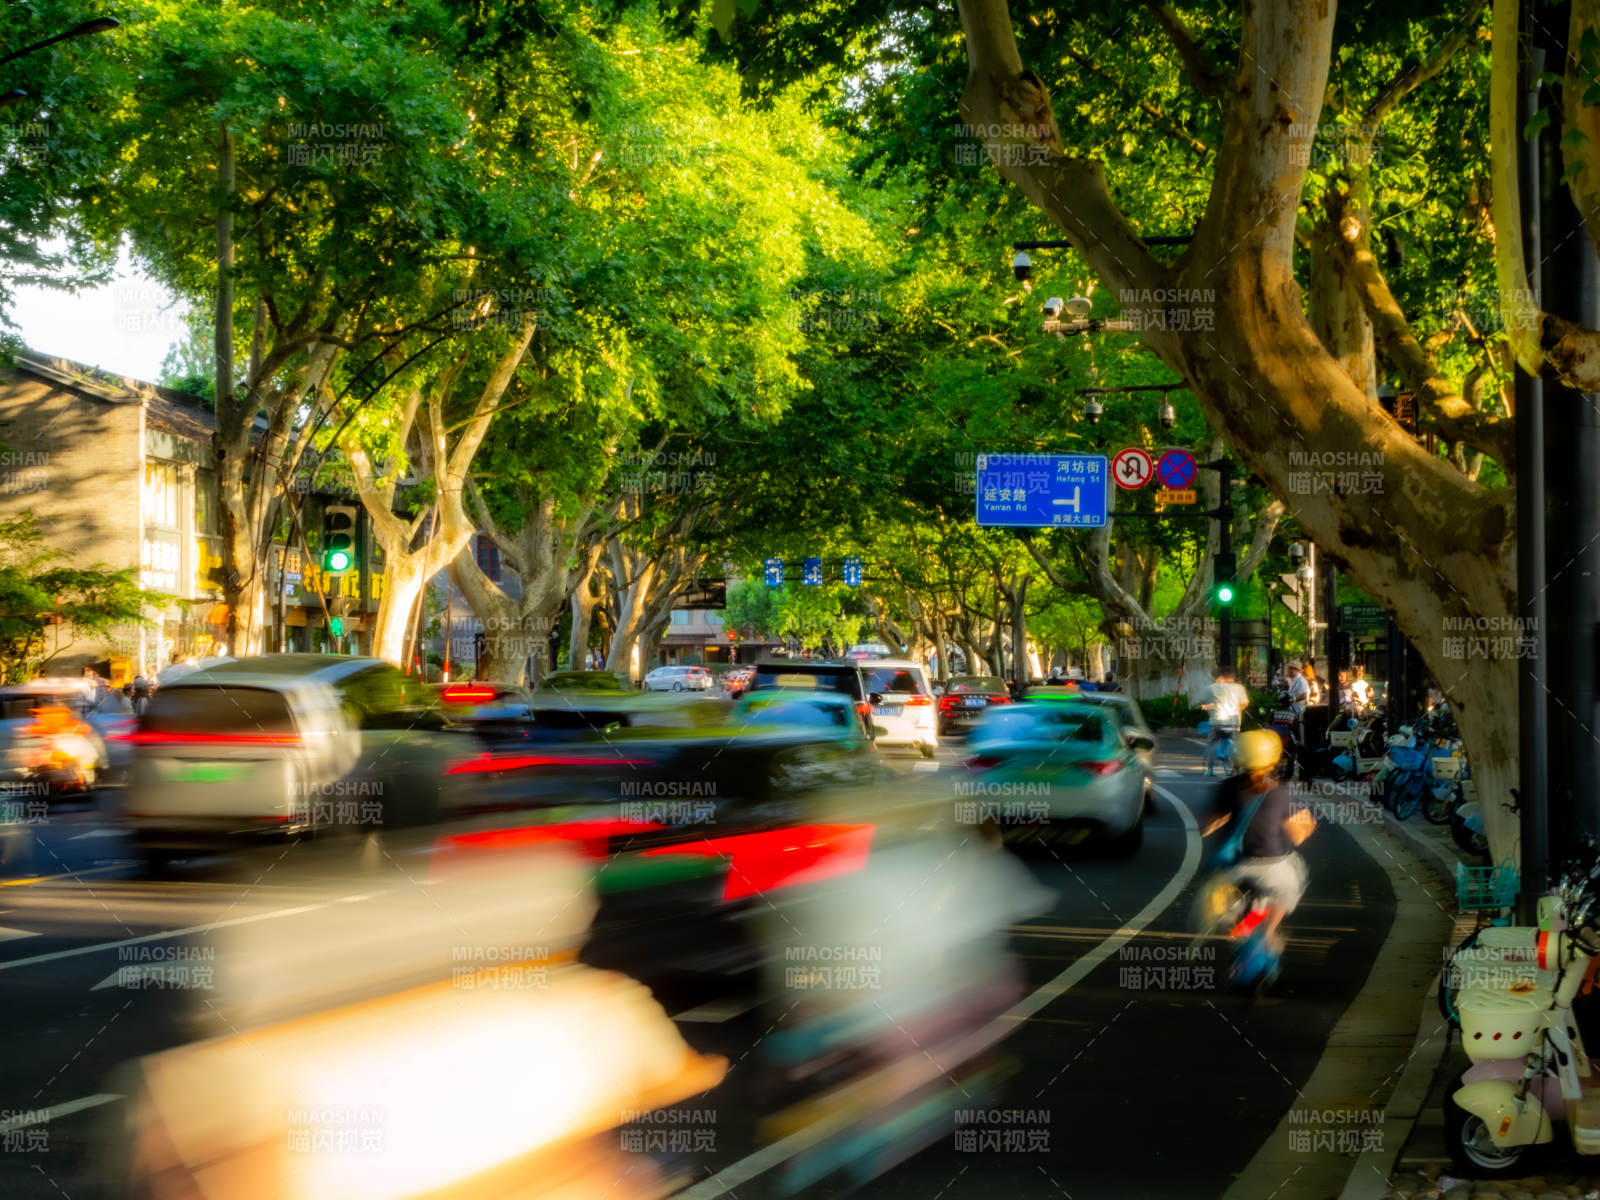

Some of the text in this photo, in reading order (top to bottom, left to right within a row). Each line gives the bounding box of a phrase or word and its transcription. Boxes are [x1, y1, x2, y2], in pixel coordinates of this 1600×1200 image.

[1057, 460, 1099, 473] 河坊街
[1056, 475, 1100, 484] Hefang St
[984, 488, 1026, 502] 延安路
[984, 503, 1027, 511] Yan'an Rd
[1053, 514, 1100, 523] 西湖大道口
